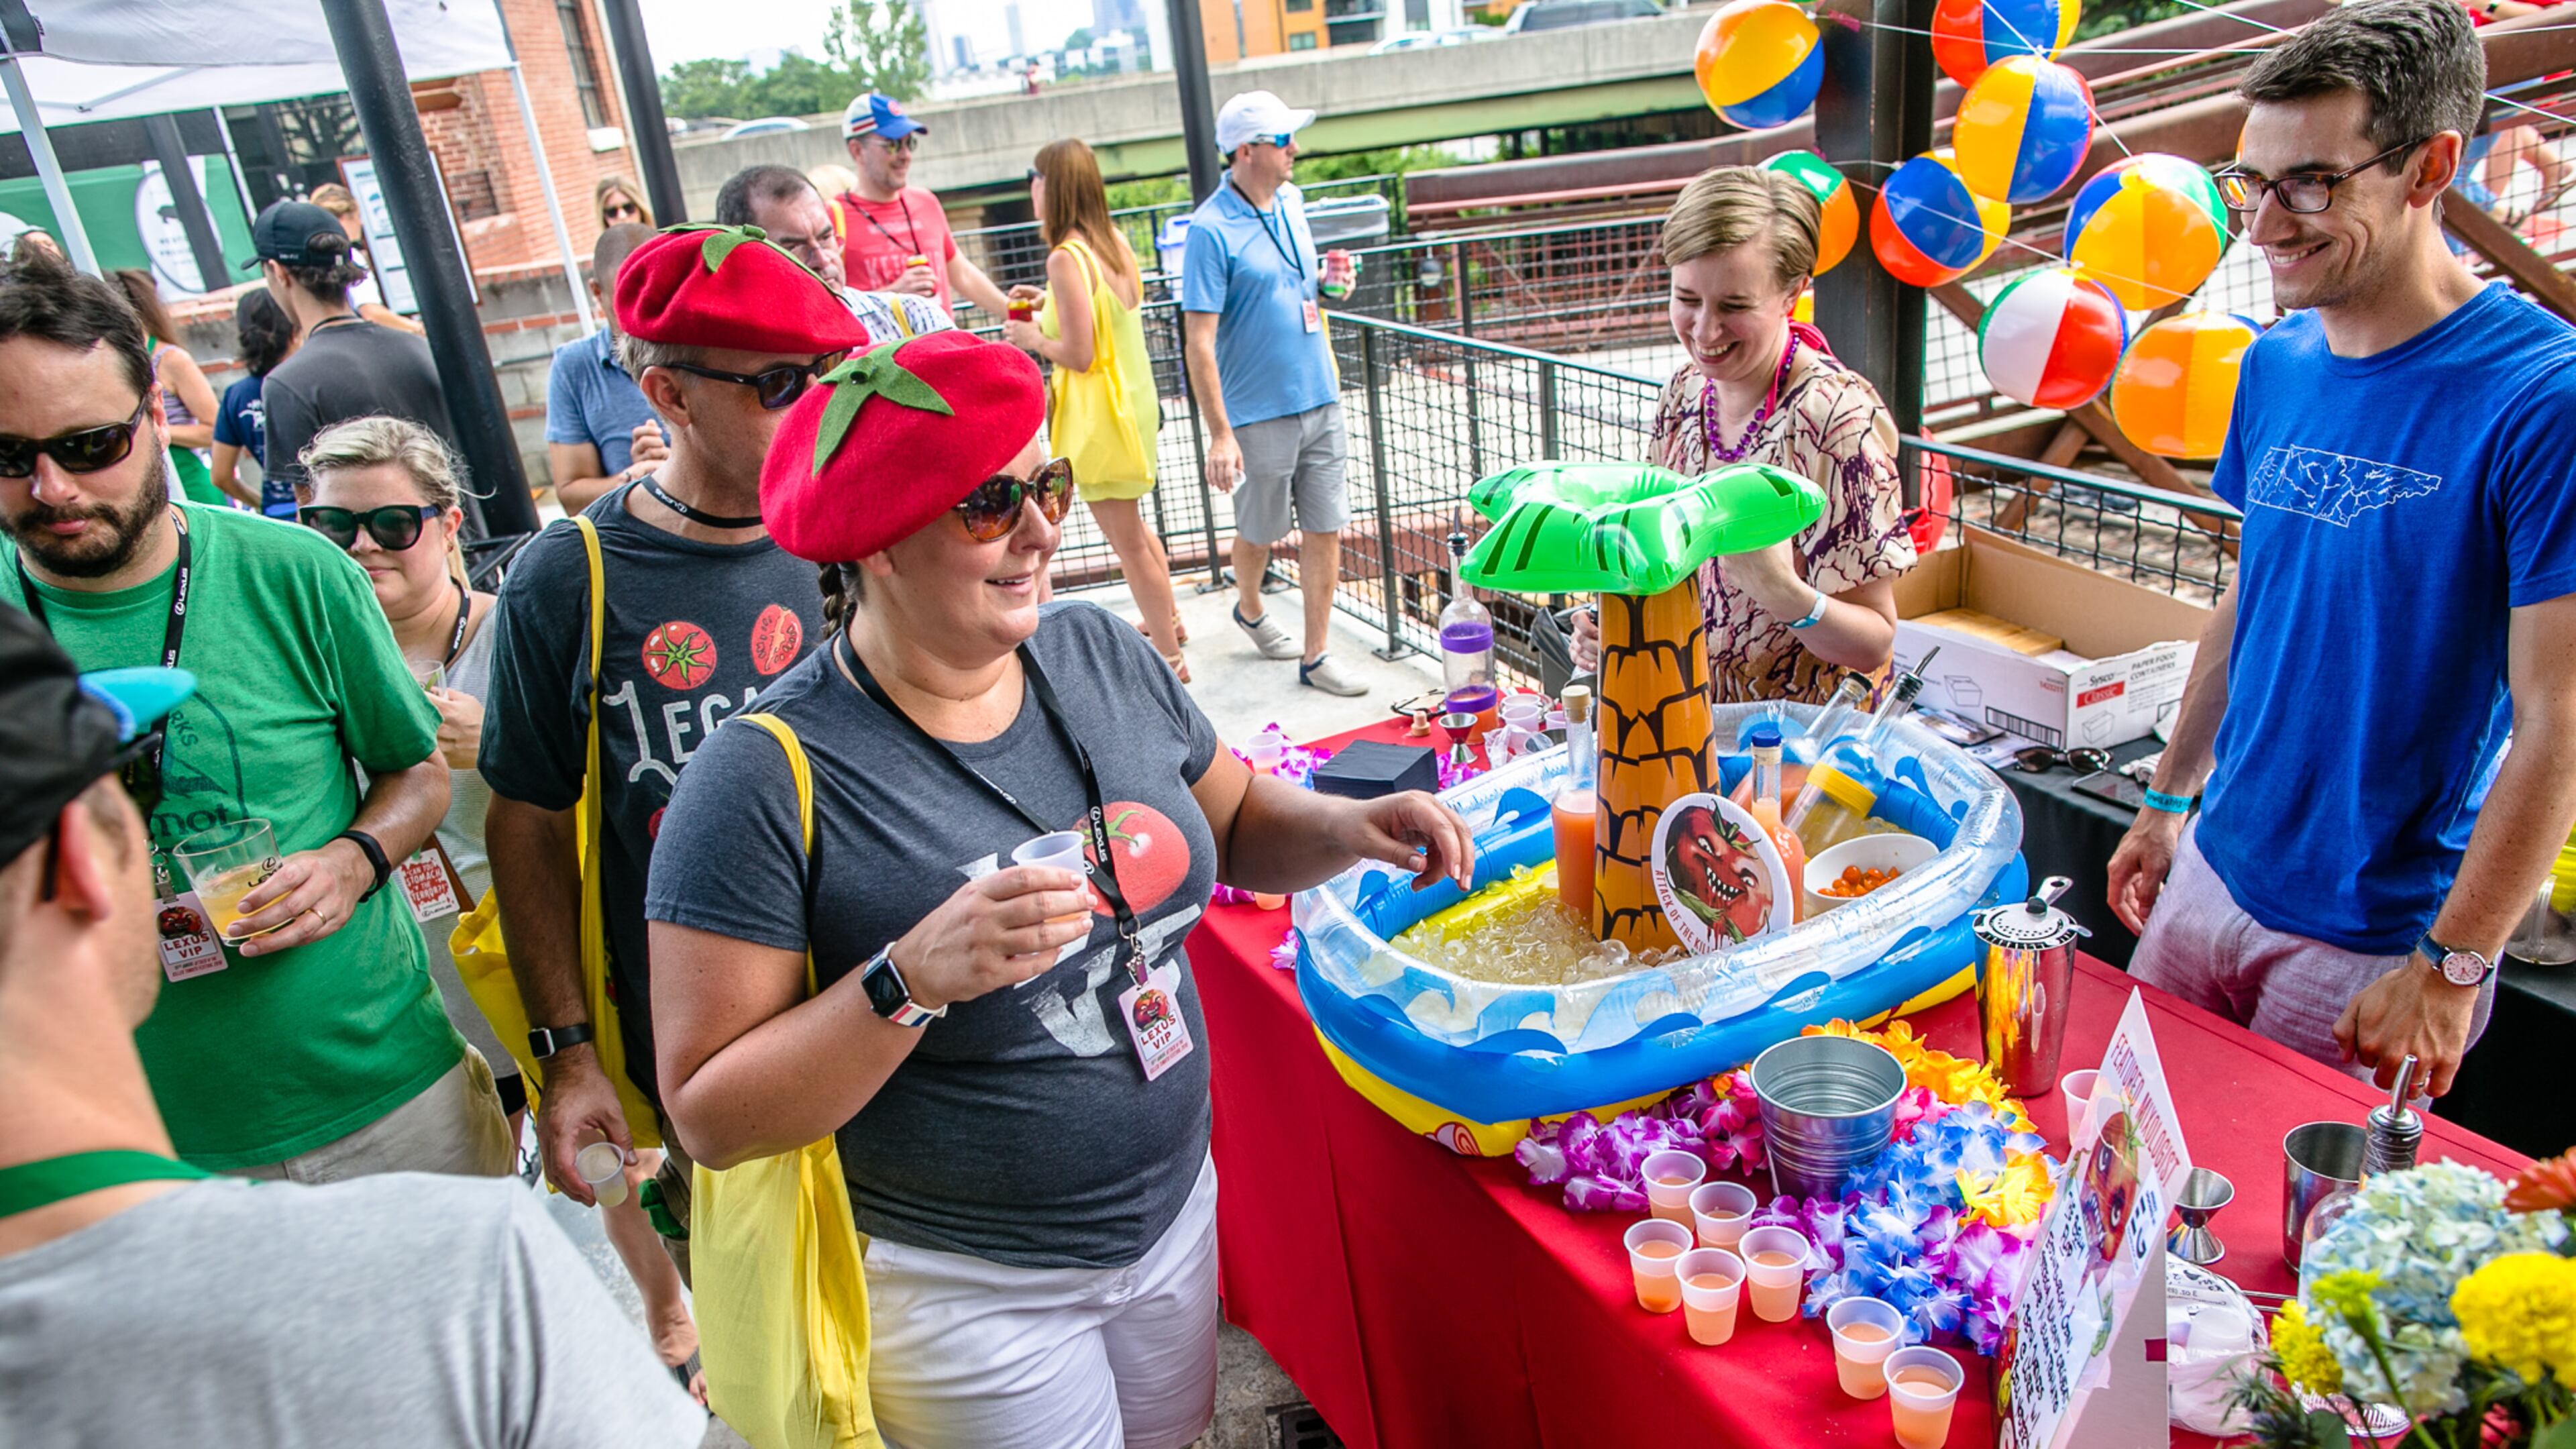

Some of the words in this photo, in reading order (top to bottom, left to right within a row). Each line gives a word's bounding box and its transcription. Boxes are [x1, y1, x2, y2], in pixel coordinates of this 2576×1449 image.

[179, 568, 188, 601] LEXUS
[167, 649, 176, 669] XUS
[2131, 657, 2154, 670] PAPER
[2089, 672, 2115, 687] Sysco
[2084, 686, 2118, 704] Classic
[168, 710, 199, 747] RKS
[1093, 820, 1108, 863] LEXUS
[1654, 869, 1674, 908] ATTACK
[1669, 908, 1682, 922] OF
[1678, 921, 1695, 943] THE
[1693, 936, 1716, 955] KILL
[163, 932, 210, 951] LEXUS
[178, 946, 203, 959] VIP
[1140, 1014, 1176, 1046] LEXUS
[1152, 1031, 1171, 1050] VIP
[2110, 1032, 2145, 1106] FEATURED
[2135, 1091, 2180, 1187] MIXOLOGIST
